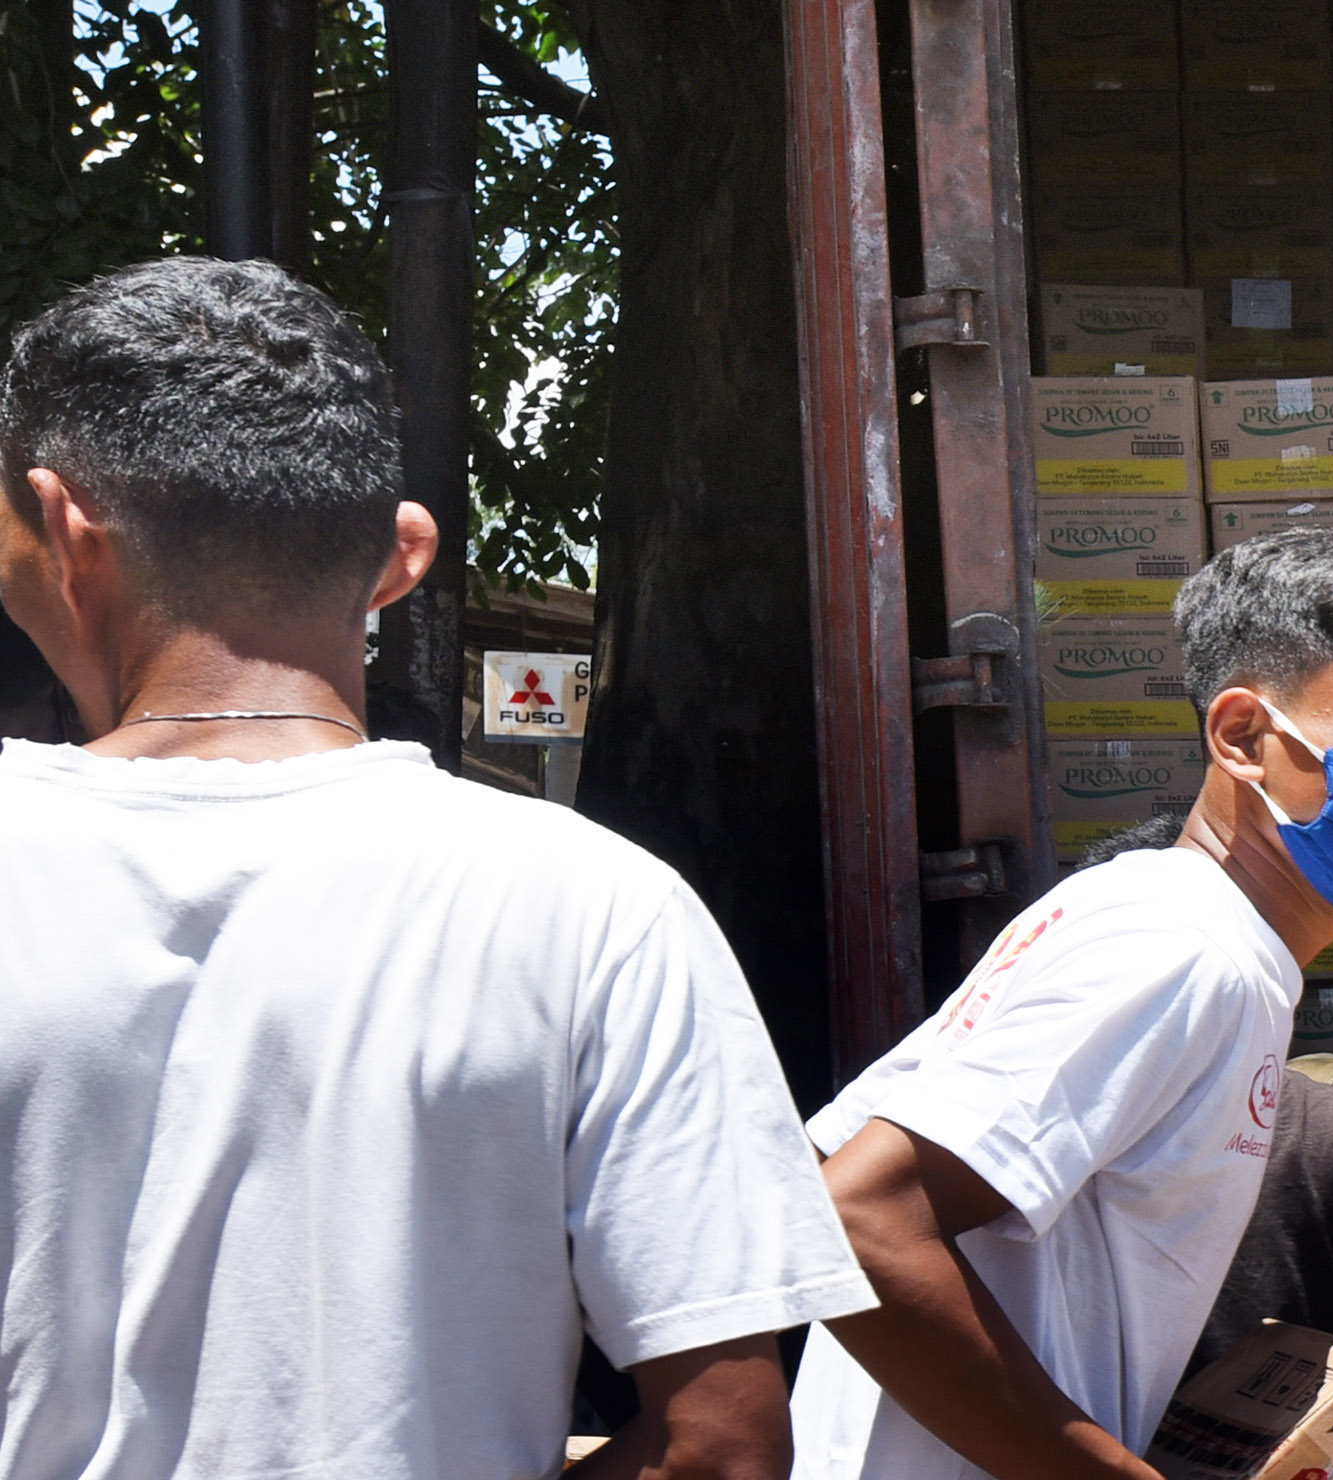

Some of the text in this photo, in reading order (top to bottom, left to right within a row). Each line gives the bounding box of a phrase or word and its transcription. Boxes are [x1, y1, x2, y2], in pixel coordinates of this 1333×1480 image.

[1045, 405, 1152, 427] PROMOO
[1051, 525, 1158, 552] PROMOO
[499, 711, 565, 726] FUSO
